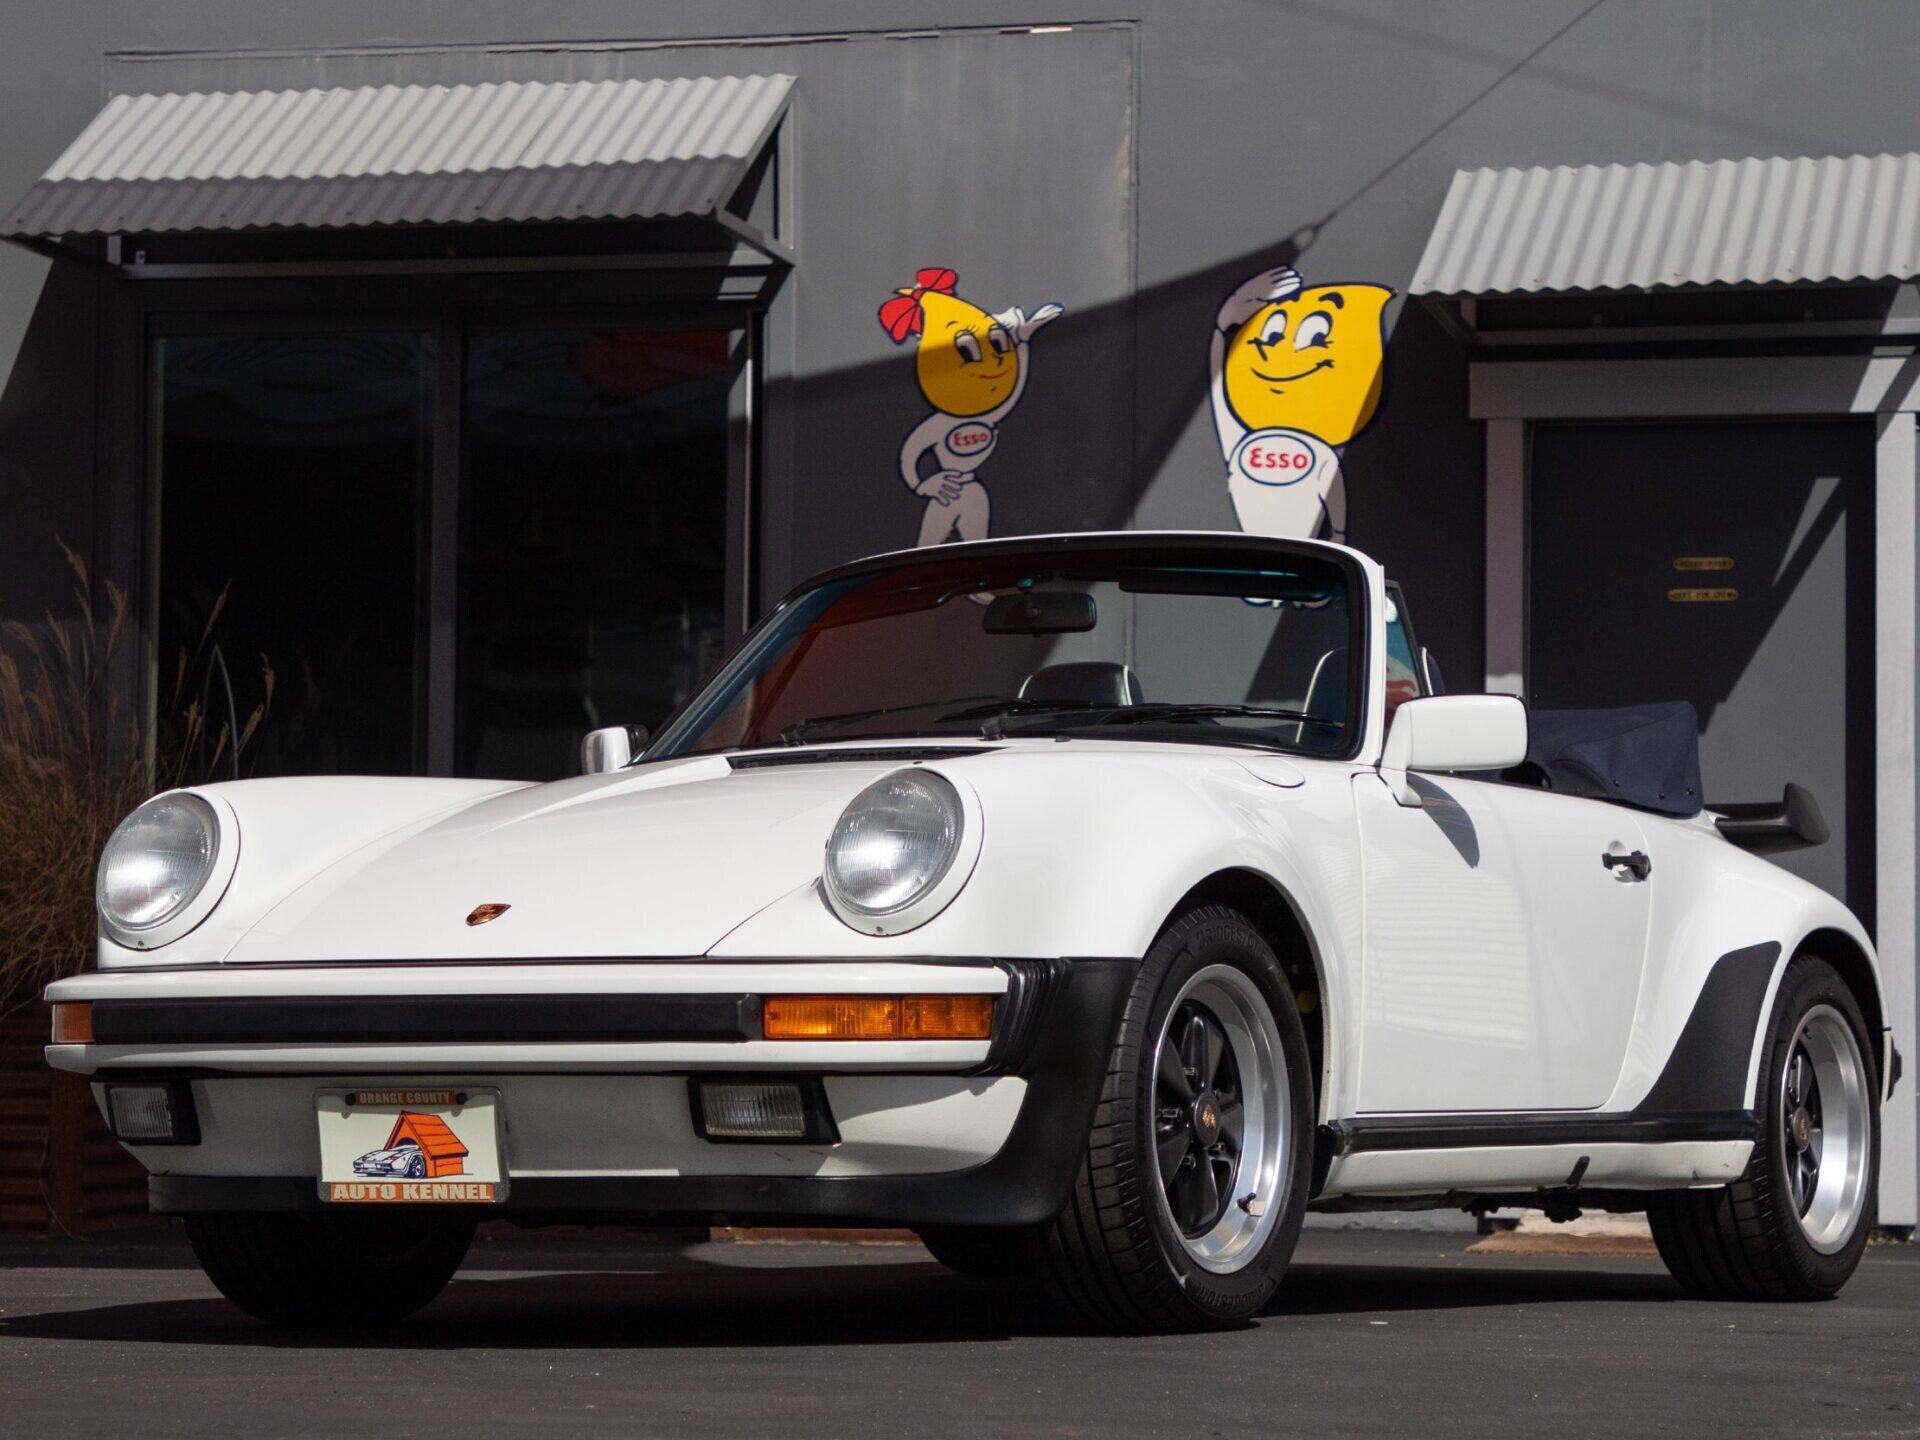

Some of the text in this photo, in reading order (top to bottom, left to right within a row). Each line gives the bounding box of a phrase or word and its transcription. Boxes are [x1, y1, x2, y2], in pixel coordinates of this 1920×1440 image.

[359, 1092, 450, 1104] ORANGE COUNTY
[333, 1184, 491, 1200] AUTO KENNEL
